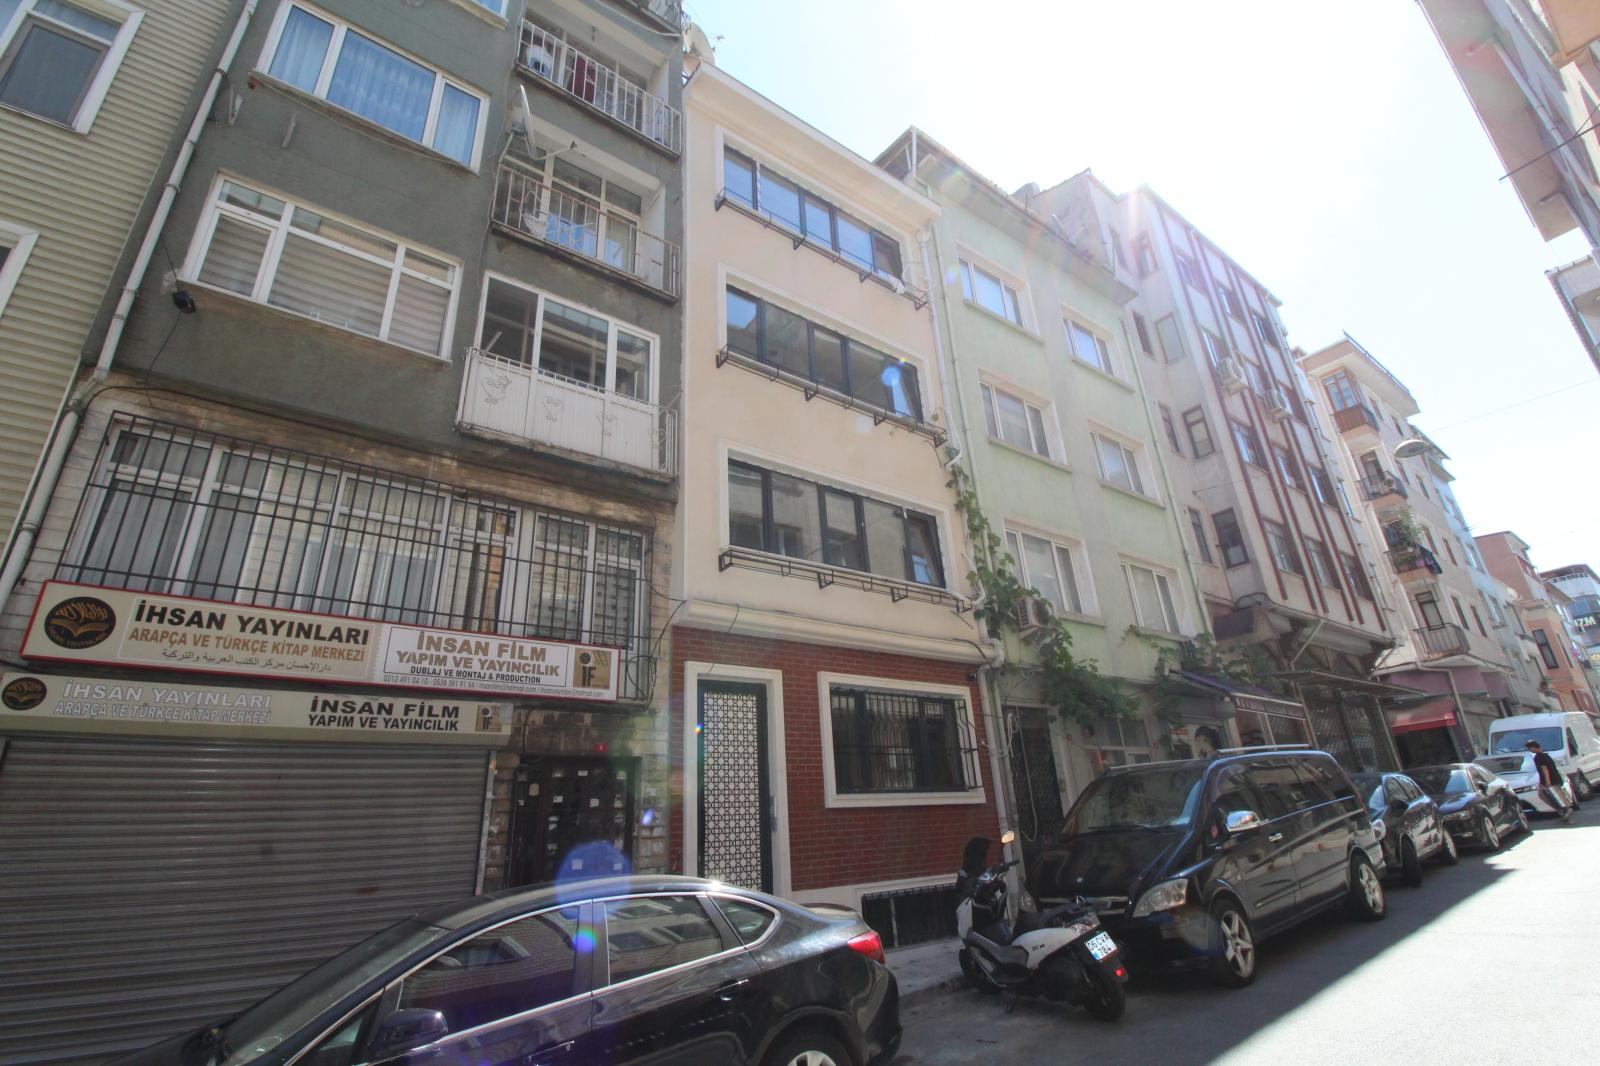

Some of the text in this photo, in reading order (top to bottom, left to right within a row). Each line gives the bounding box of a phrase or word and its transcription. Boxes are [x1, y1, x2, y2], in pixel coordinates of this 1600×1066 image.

[135, 600, 226, 630] İHSAN
[237, 615, 369, 645] YAYINLARI
[129, 627, 187, 647] ARAPÇA
[193, 634, 210, 648] VE
[215, 634, 268, 655] TÜRKÇE
[271, 640, 309, 656] KİTAP
[312, 645, 364, 661] MERKEZİ
[417, 631, 546, 662] İNSAN FİLM
[396, 650, 560, 676] YAPIM VE YAYINCILIK
[410, 666, 442, 676] DUBLAJ
[444, 668, 454, 677] VE
[456, 669, 487, 680] MONTAJ
[496, 673, 541, 683] PRODUCTION
[63, 680, 143, 701] İHSAN
[152, 687, 271, 709] YAYINLARI
[310, 696, 459, 718] İNSAN FİLM
[112, 704, 128, 717] VE
[309, 714, 458, 731] YAPIM VE YAYINCILIK
